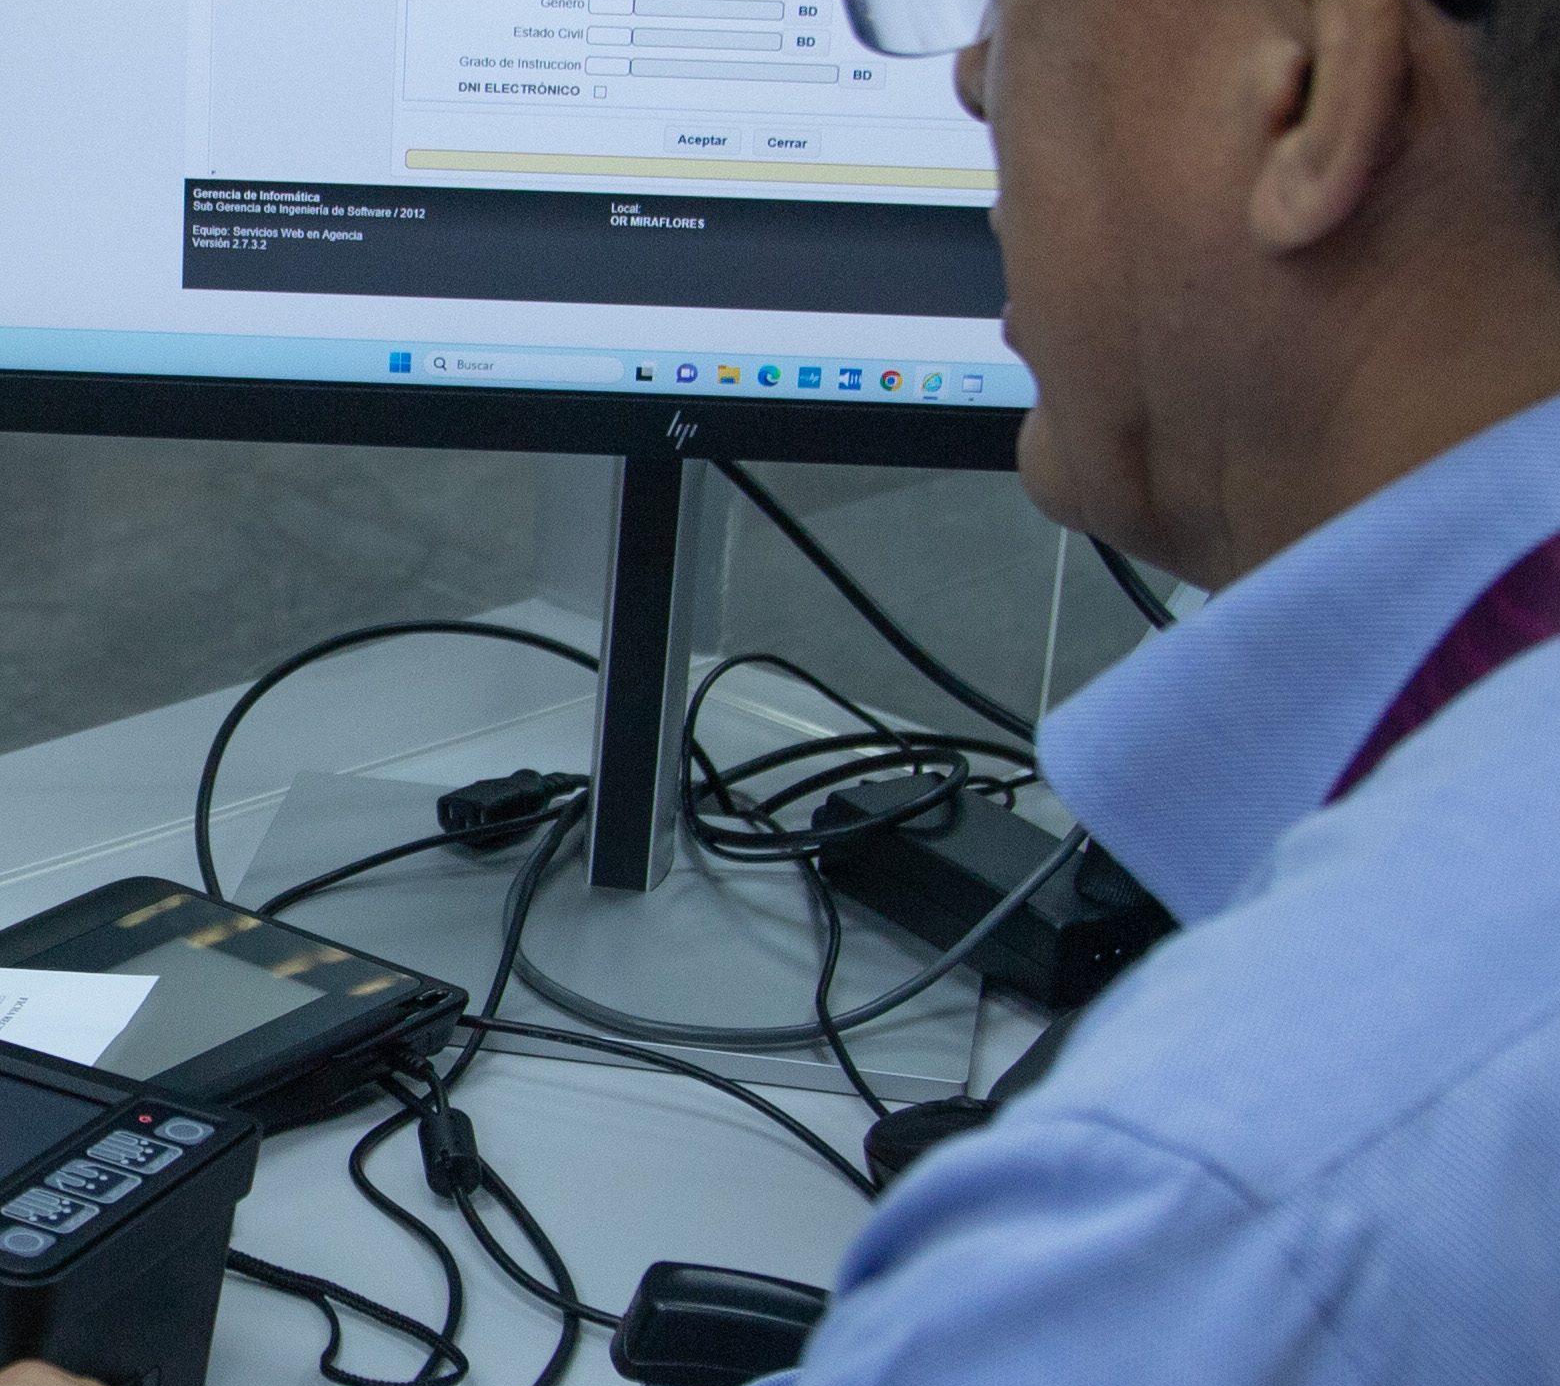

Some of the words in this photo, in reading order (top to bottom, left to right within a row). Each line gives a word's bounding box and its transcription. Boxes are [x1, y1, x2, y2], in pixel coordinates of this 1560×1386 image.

[799, 5, 818, 17] BD
[513, 26, 554, 39] Estado
[558, 27, 584, 40] Civil
[796, 36, 815, 48] BD
[459, 57, 500, 69] Grado
[502, 58, 515, 69] de
[518, 58, 581, 71] Instruccion
[853, 70, 872, 81] BD
[458, 82, 481, 94] DNI
[485, 81, 580, 96] ELECTRÓNICO
[677, 134, 728, 149] Aceptar
[767, 137, 807, 149] Cerrar
[193, 189, 241, 200] Gerencia
[244, 190, 257, 200] de
[260, 190, 320, 203] Informática
[193, 201, 213, 211] Sub
[216, 202, 261, 213] Gerencia
[264, 203, 277, 213] de
[279, 204, 329, 217] Ingeniería
[331, 206, 345, 216] de
[347, 206, 392, 218] Software
[400, 208, 426, 219] 2012
[611, 202, 641, 214] Local:
[610, 215, 628, 226] OR
[630, 216, 705, 229] MIRAFLORES
[192, 225, 230, 238] Equipo:
[233, 227, 278, 238] Servicios
[281, 228, 304, 239] Web
[307, 231, 320, 239] en
[322, 230, 363, 241] Agencia
[192, 237, 230, 249] Versión
[232, 239, 267, 250] 2.7.3.2
[456, 359, 495, 371] Buscar
